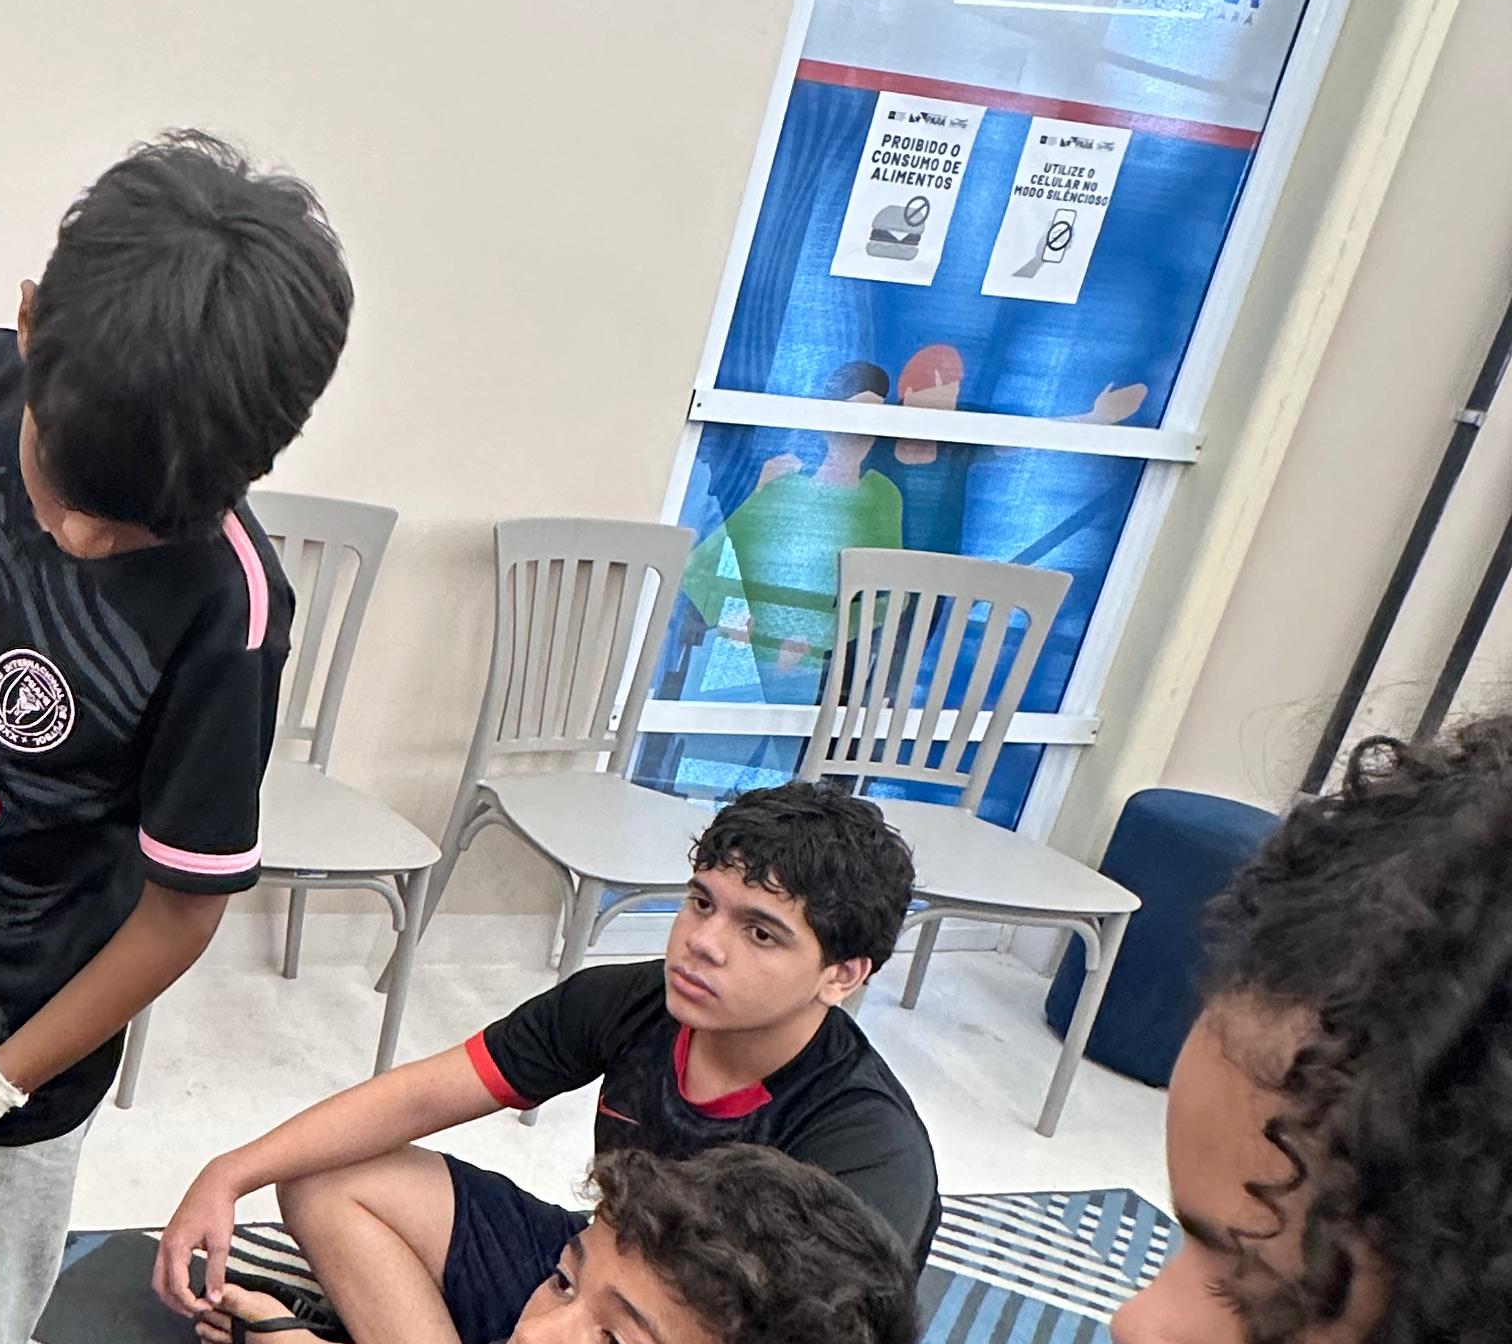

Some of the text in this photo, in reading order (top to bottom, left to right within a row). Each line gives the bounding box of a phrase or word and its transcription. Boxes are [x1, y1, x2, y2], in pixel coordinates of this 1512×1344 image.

[881, 133, 961, 157] PROIBIDO O
[871, 149, 963, 175] CONSUMO DE
[1043, 162, 1096, 179] UTILIZE O
[870, 167, 953, 190] ALIMENTOS
[1030, 174, 1099, 193] CELULAR NO
[1013, 185, 1045, 199] MODO
